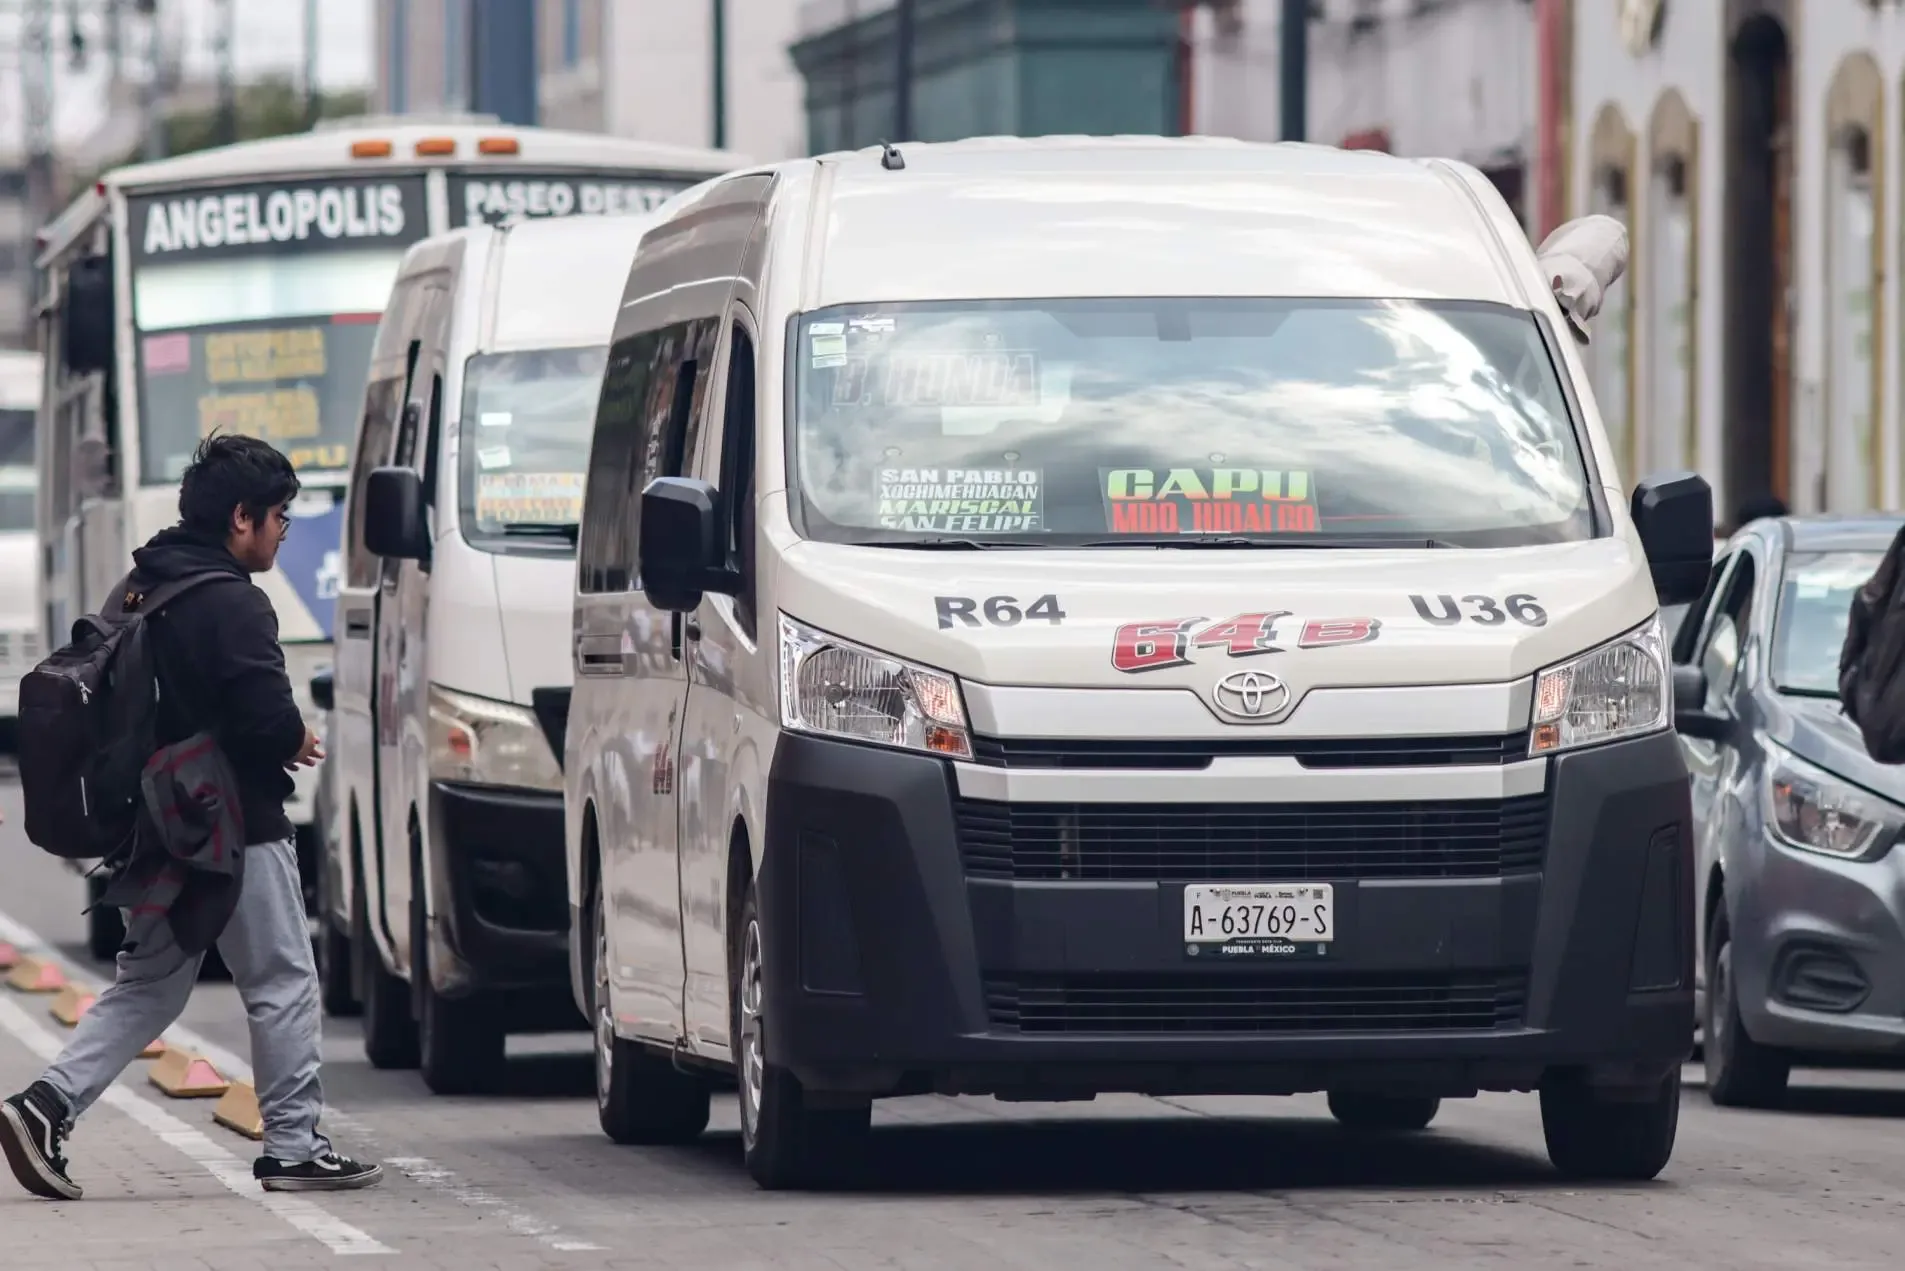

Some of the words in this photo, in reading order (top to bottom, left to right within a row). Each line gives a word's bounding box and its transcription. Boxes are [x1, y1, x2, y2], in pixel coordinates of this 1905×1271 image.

[465, 181, 574, 217] PASEO
[144, 184, 405, 254] ANGELOPOLIS
[880, 469, 939, 484] SAN
[947, 469, 1037, 485] PABLO
[1107, 468, 1309, 501] CAPU
[880, 500, 1037, 515] MARISCAL
[880, 515, 936, 531] SAN
[934, 594, 1066, 631] R64
[1408, 594, 1547, 628] U36
[1190, 904, 1327, 936] A-63769-S
[1222, 946, 1254, 954] PUEBLA
[1261, 943, 1296, 954] MÉXICO
